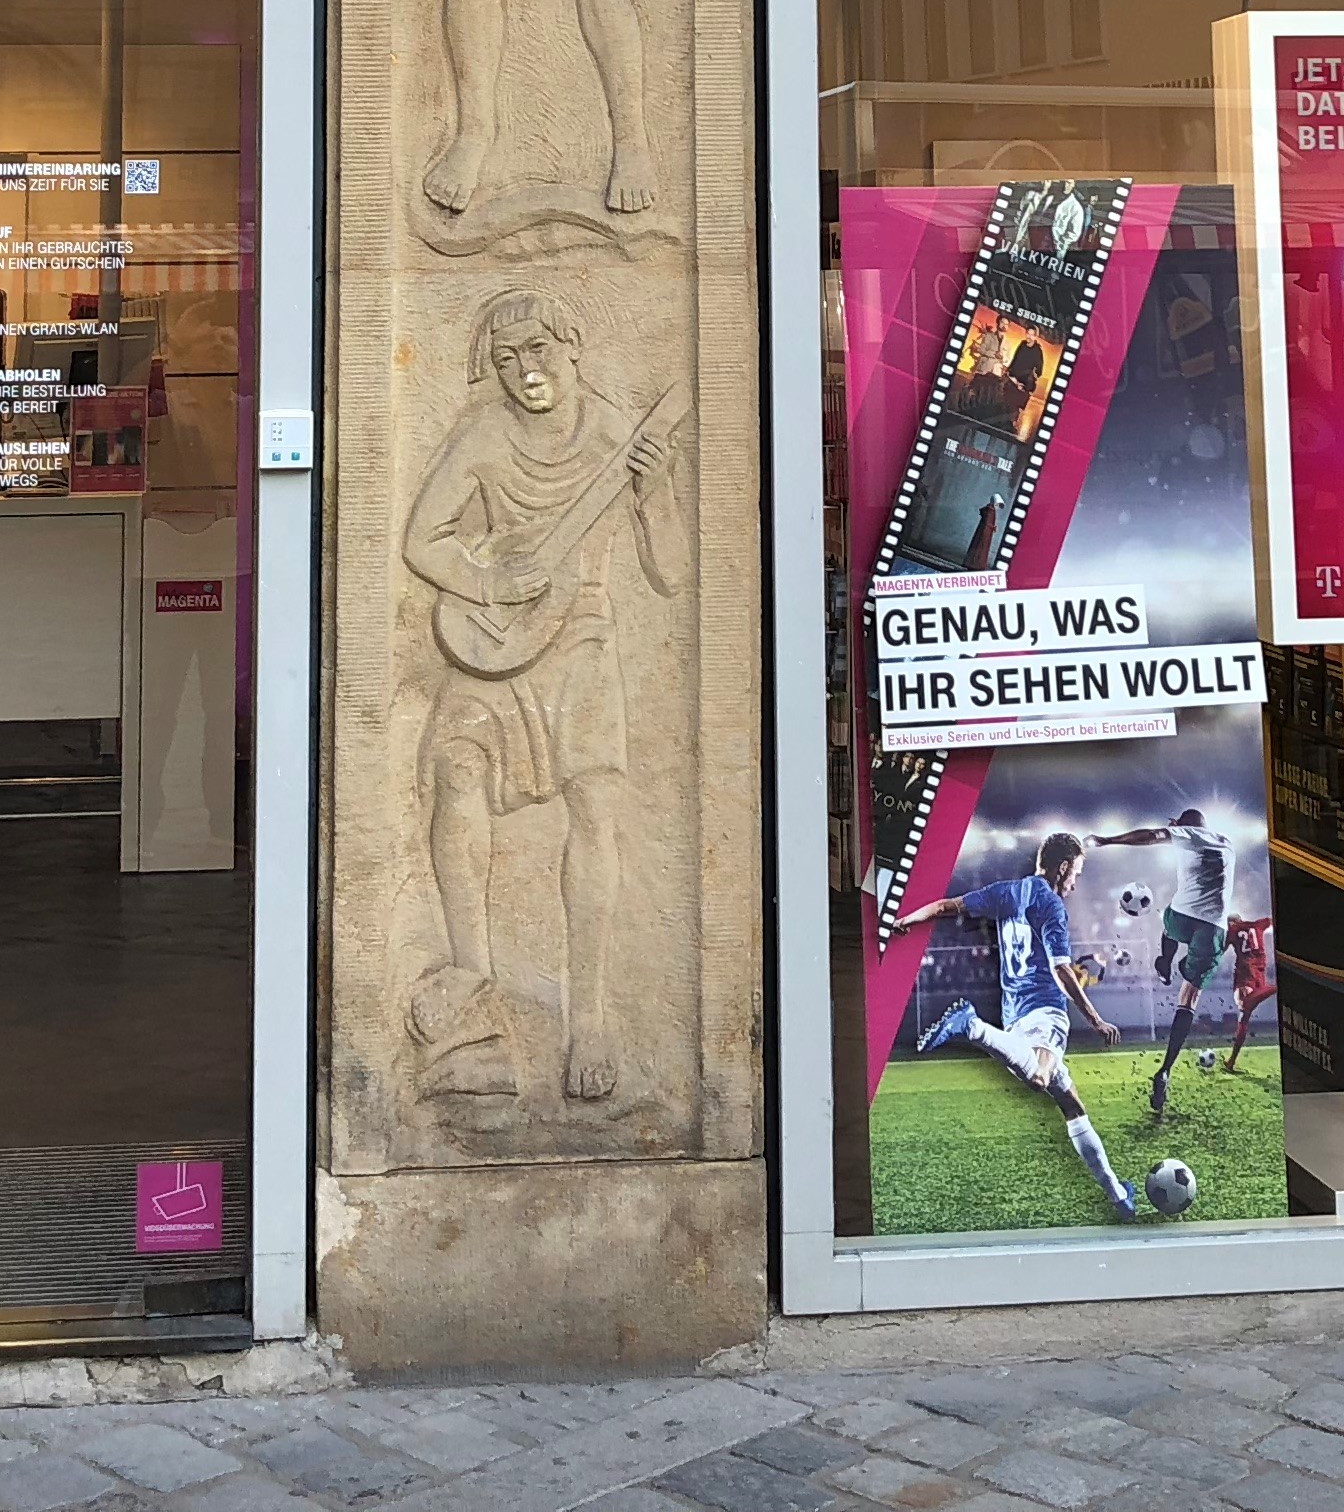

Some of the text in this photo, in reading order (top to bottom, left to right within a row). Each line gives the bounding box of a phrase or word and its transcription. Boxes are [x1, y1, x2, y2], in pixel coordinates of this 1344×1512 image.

[0, 178, 27, 192] UNS
[29, 178, 58, 192] ZEIT
[60, 176, 87, 192] FÜR
[89, 178, 110, 192] SIE
[11, 240, 35, 255] IHR
[37, 240, 134, 255] GEBRAUCHTES
[8, 257, 48, 270] EINEN
[50, 257, 126, 270] GUTSCHEIN
[1000, 238, 1086, 281] VALKYRIEN
[992, 298, 1058, 329] GET SHORTY
[30, 322, 119, 336] GRATIS-WLAN
[22, 384, 107, 397] BESTELLUNG
[13, 400, 60, 414] BEREIT
[20, 457, 64, 471] VOLLE
[875, 574, 1002, 592] MAGENTA VERBINDET
[157, 594, 220, 608] MAGENTA
[881, 596, 1141, 647] GENAU, WAS
[884, 672, 958, 712] IHR
[969, 663, 1111, 707] SEHEN
[1119, 653, 1257, 698] WOLLT
[887, 718, 1169, 746] Exklusive Serien und Live-Sport bei EntertainTV
[1237, 927, 1261, 954] 21
